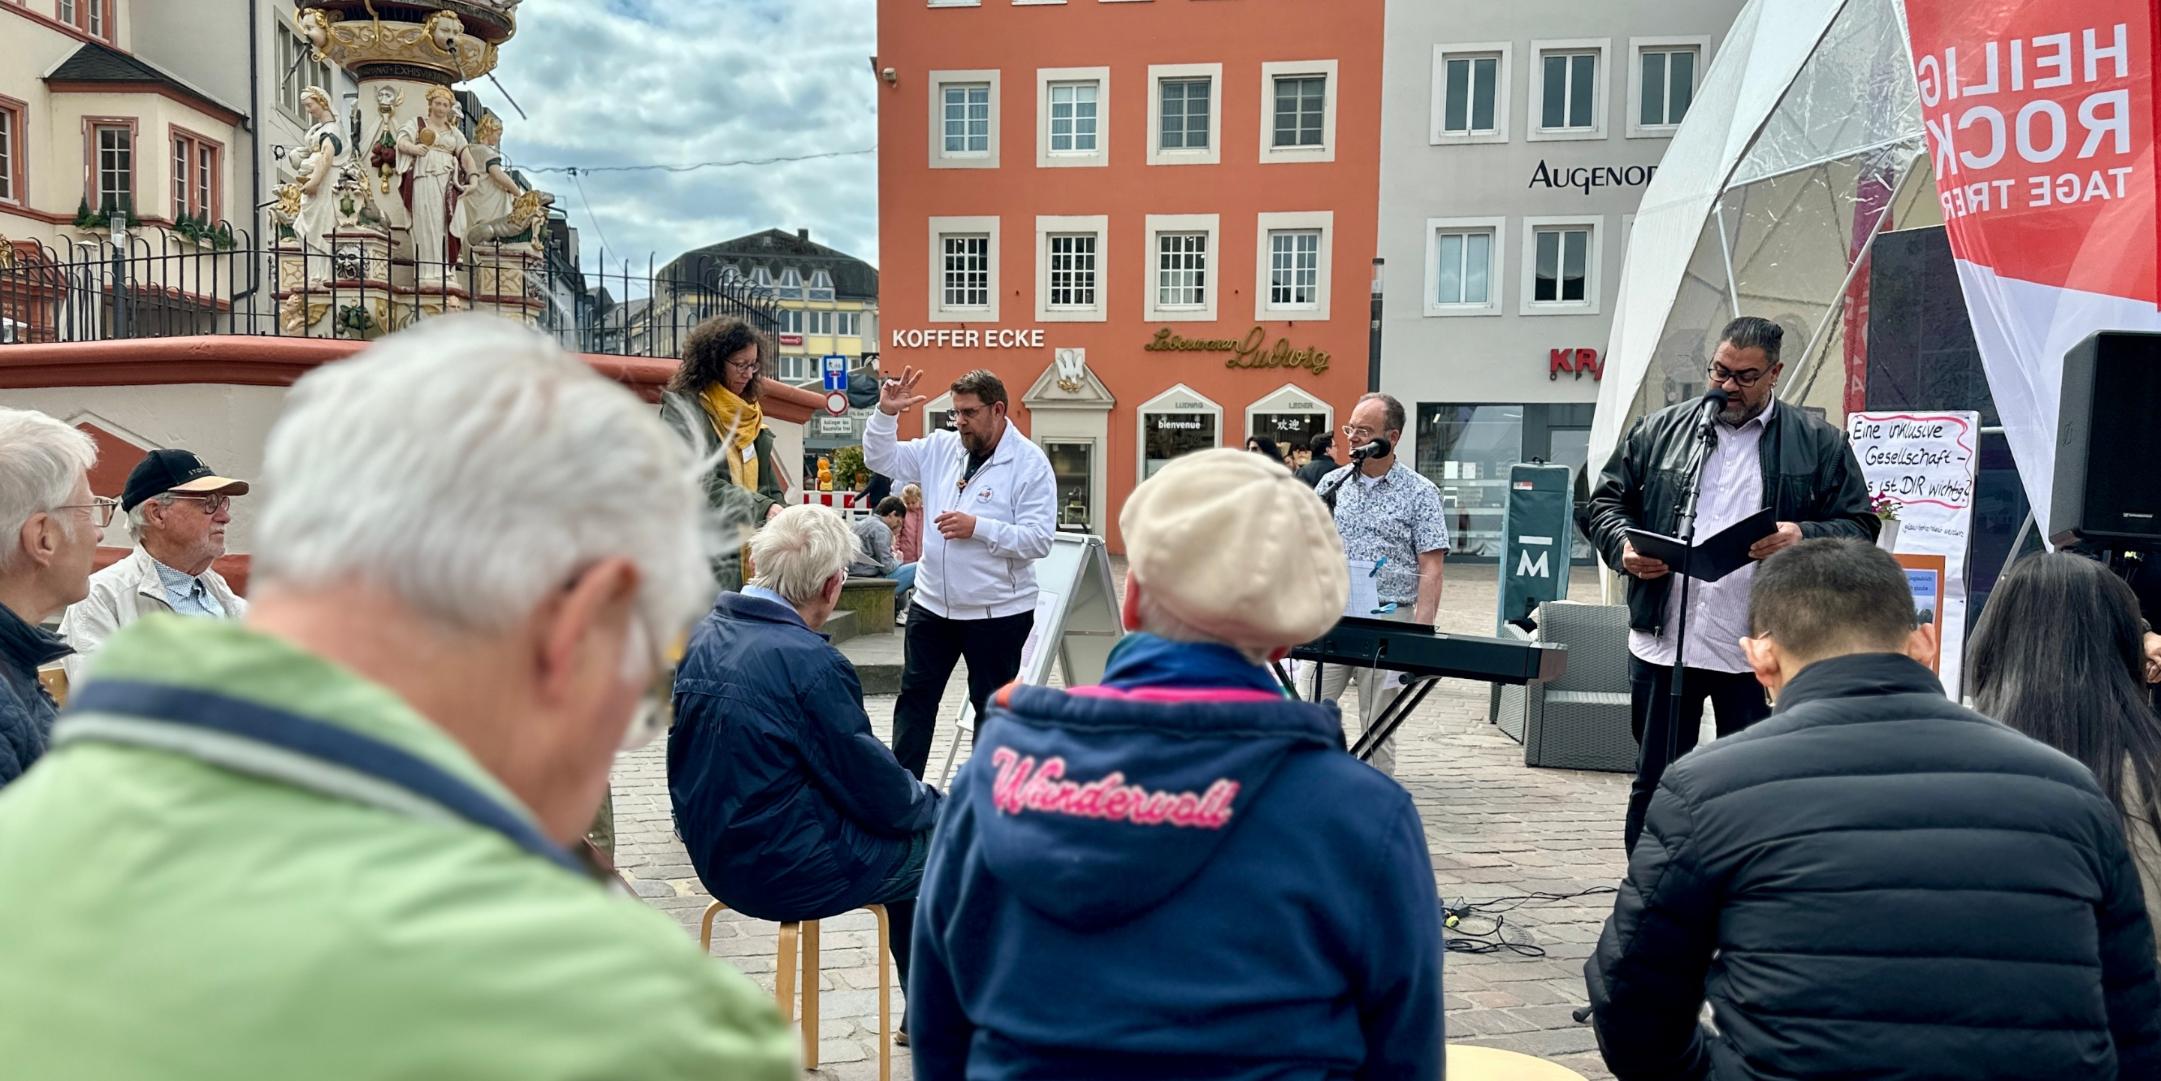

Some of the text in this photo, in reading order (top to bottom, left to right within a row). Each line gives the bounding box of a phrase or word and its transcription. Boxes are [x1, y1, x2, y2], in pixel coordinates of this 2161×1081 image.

[892, 328, 1045, 348] KOFFER ECKE
[1225, 326, 1331, 375] Ludwig
[1158, 419, 1201, 430] bienvenue
[1277, 419, 1301, 431] 欢迎
[1853, 421, 1943, 440] Eine inklusive
[1865, 445, 1952, 467] Gesellschaft
[1880, 478, 1898, 492] ist
[1900, 475, 1926, 495] DIR
[1516, 549, 1550, 578] M
[991, 746, 1241, 830] Wundervoll
